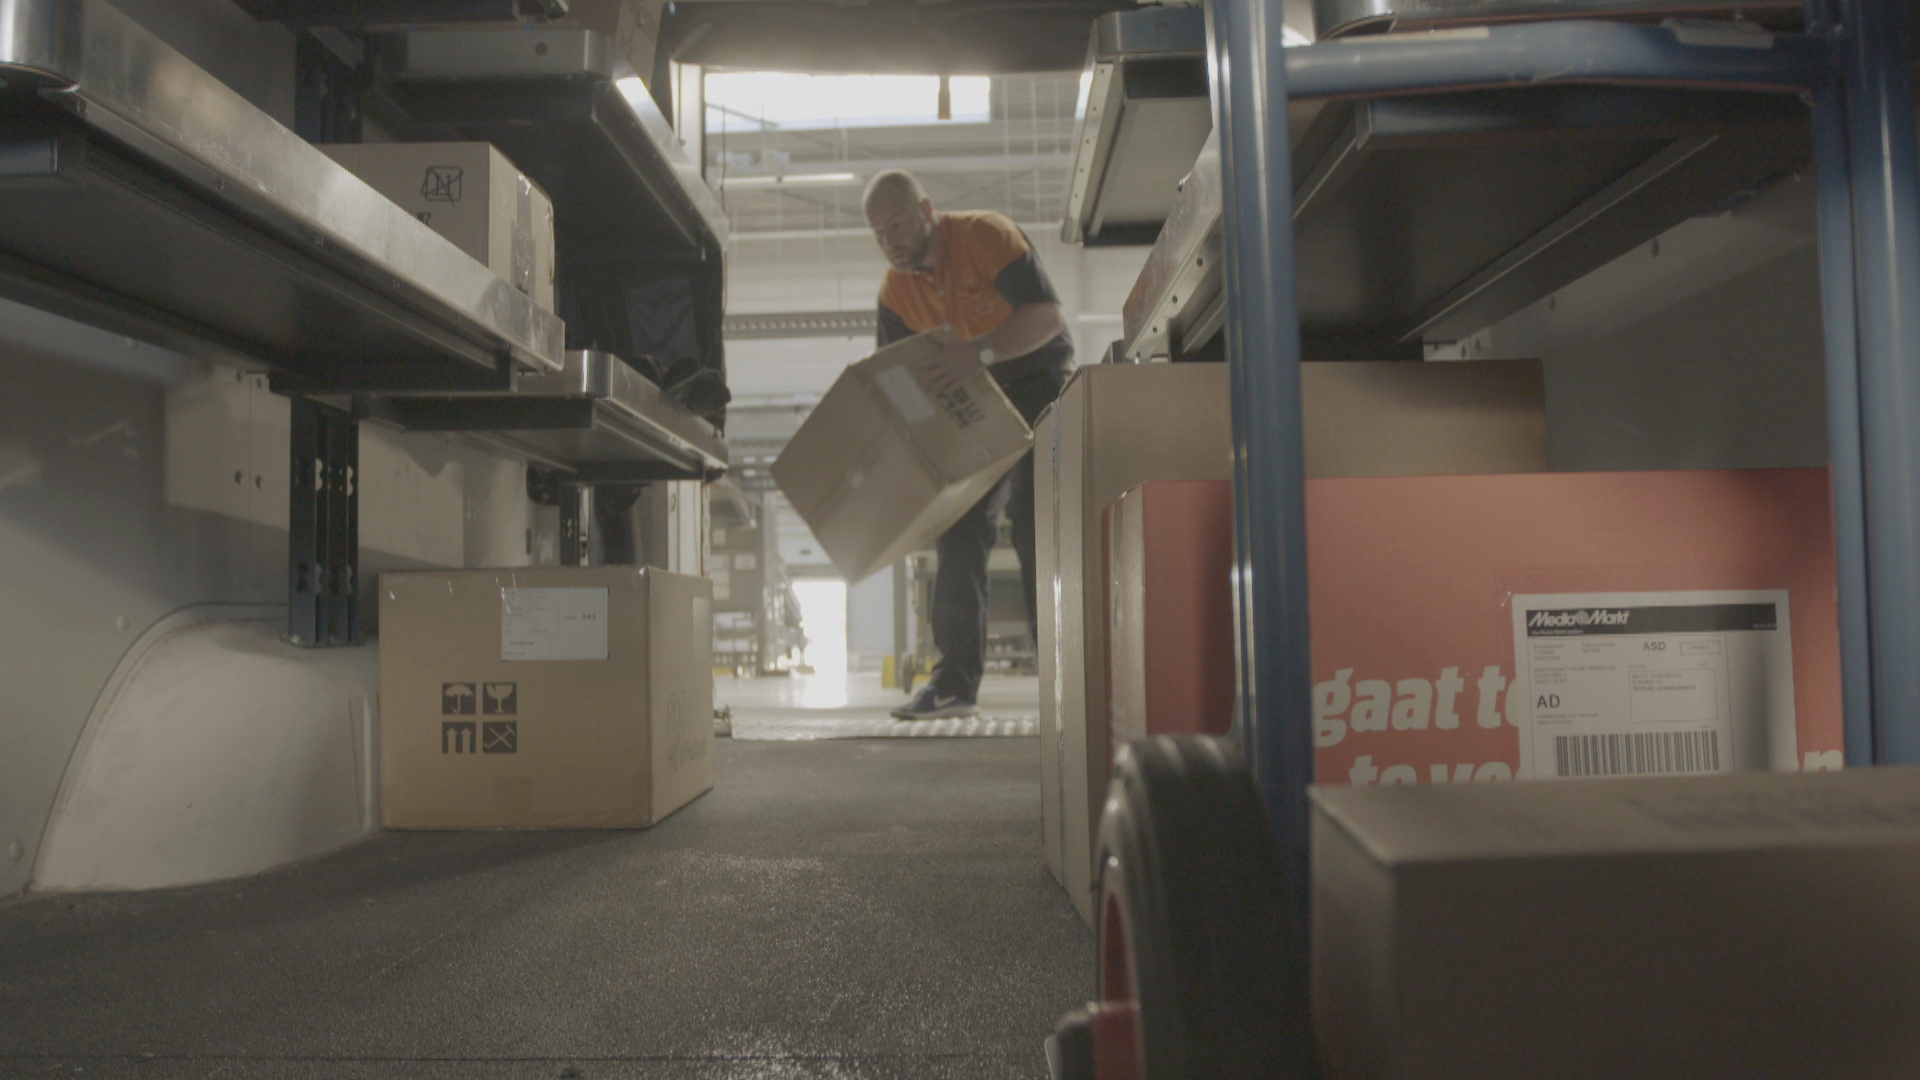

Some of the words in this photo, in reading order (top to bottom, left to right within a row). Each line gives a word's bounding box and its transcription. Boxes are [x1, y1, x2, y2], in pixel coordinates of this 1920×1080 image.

[1528, 611, 1577, 627] Media
[1586, 609, 1630, 625] Markt
[1643, 641, 1666, 651] ASD
[1313, 666, 1465, 748] gaat
[1536, 693, 1560, 709] AD
